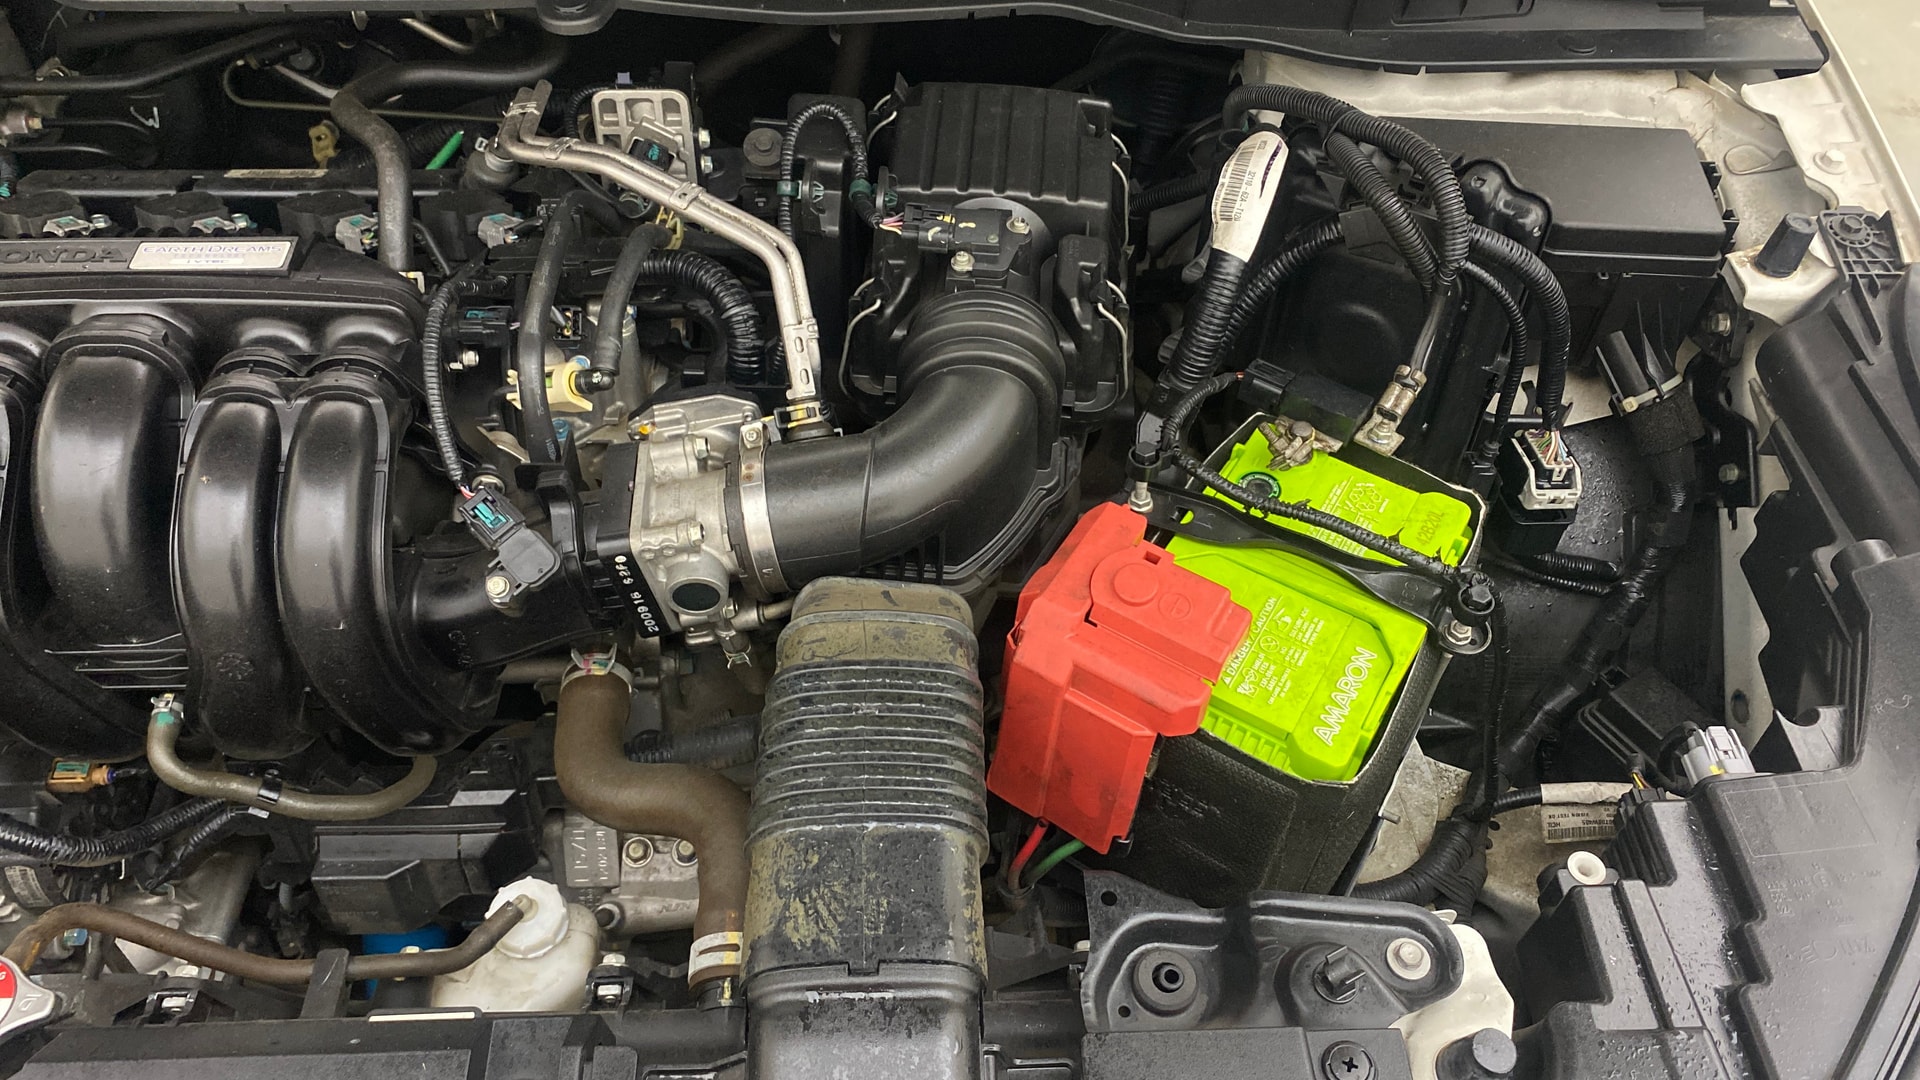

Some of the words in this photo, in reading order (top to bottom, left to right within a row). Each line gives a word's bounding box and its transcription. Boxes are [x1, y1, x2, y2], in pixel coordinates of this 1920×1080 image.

[0, 248, 127, 263] ONDA
[143, 245, 205, 253] EARTH
[208, 245, 282, 253] DREAMS
[1254, 597, 1277, 633] CAUTION
[1313, 647, 1378, 746] AMARON
